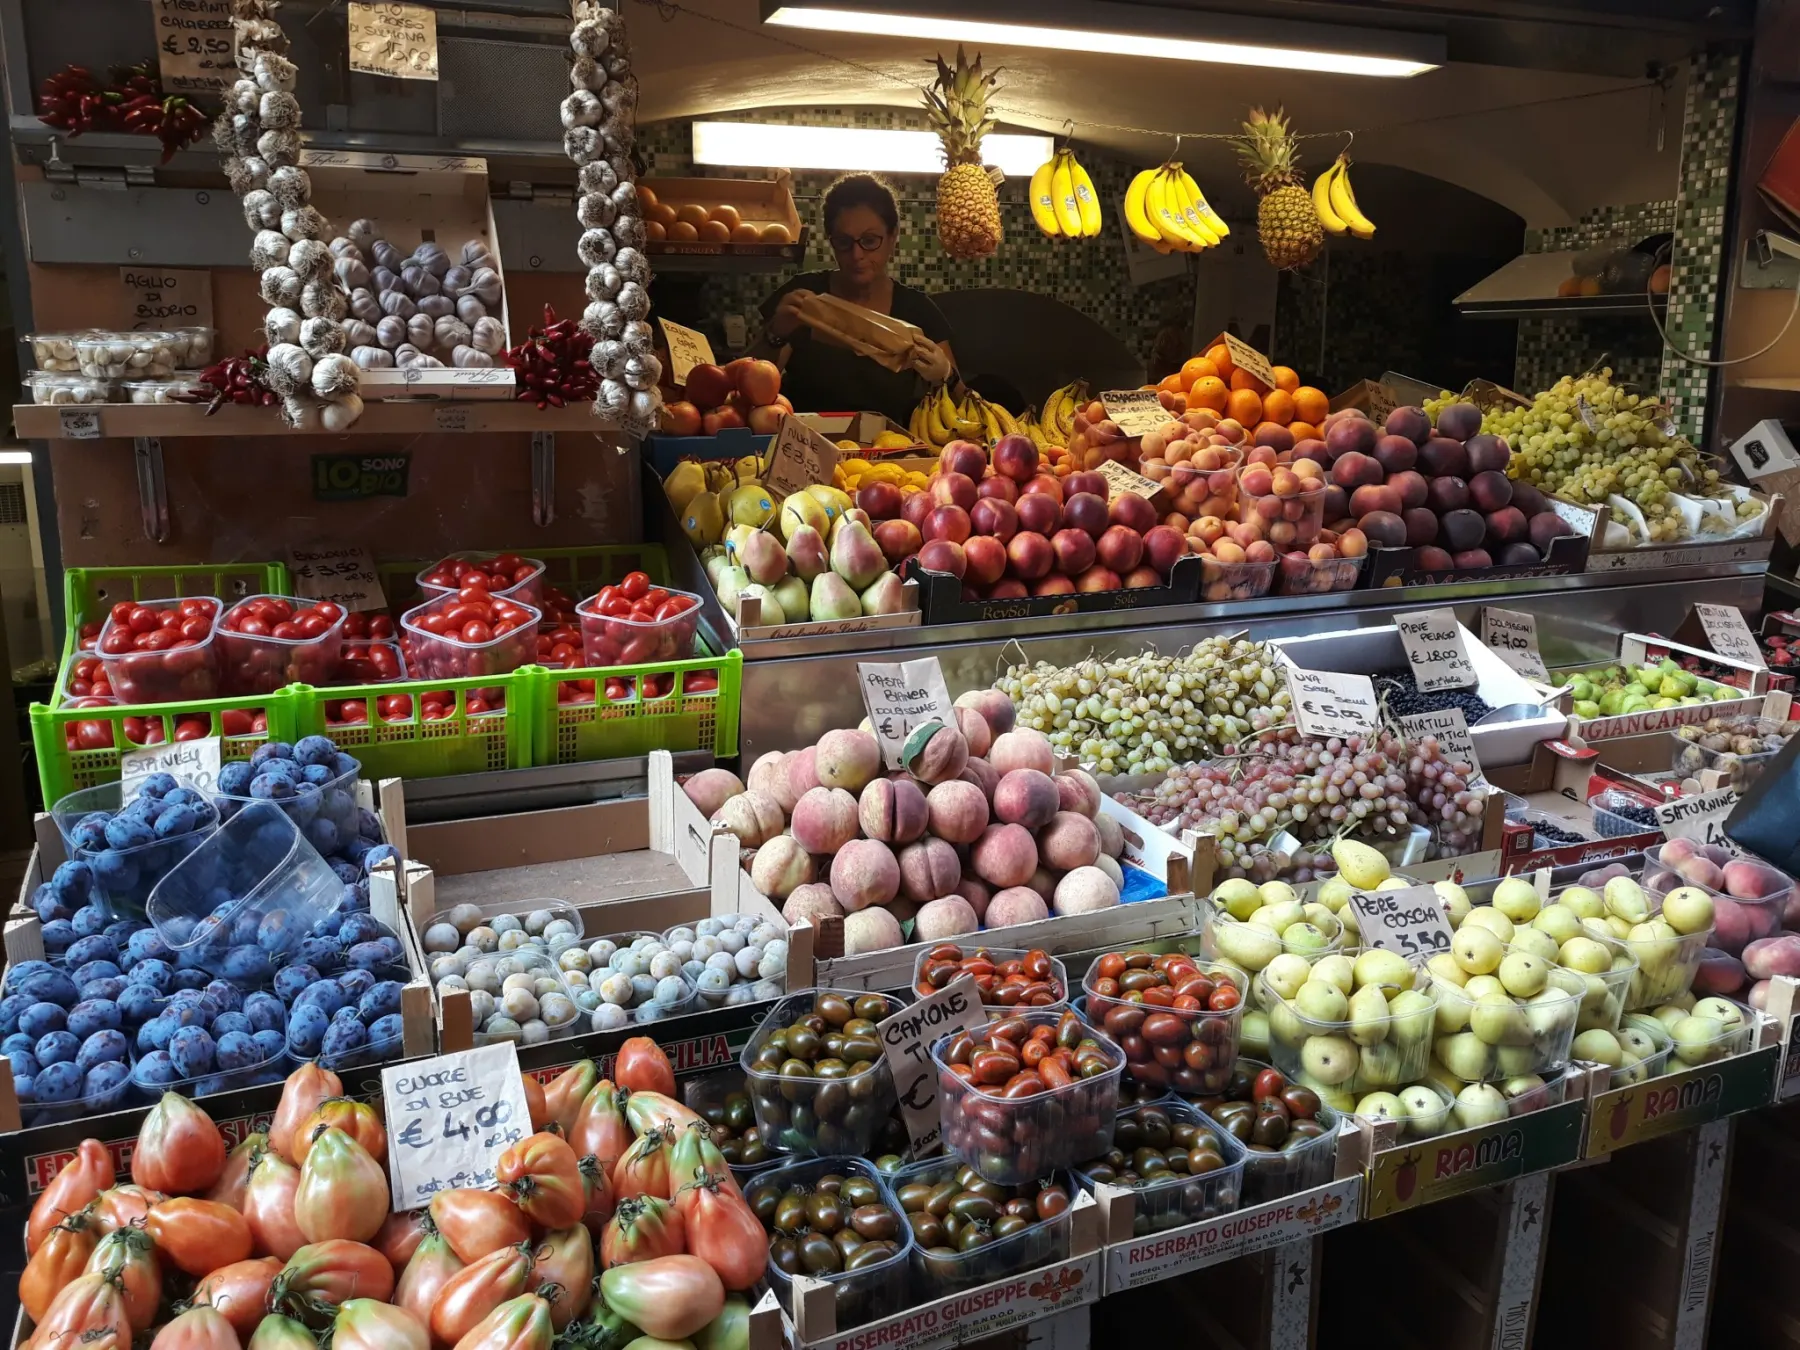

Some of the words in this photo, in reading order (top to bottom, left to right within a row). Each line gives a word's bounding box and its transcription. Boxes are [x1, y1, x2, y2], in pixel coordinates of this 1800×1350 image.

[350, 23, 359, 33] DI
[162, 34, 185, 55] €
[187, 36, 231, 55] 2,50
[351, 41, 371, 52] €
[125, 273, 177, 289] AGLIO
[145, 292, 162, 302] DI
[133, 304, 197, 318] BUDRIO
[781, 442, 792, 458] €
[361, 458, 406, 471] SONO
[361, 471, 403, 494] BIO
[296, 565, 314, 578] €
[1114, 594, 1137, 605] Solo
[1401, 622, 1428, 635] PIEVE
[1420, 630, 1456, 643] PELAGO
[1490, 631, 1499, 647] €
[1501, 631, 1528, 651] 7,00
[1411, 650, 1424, 664] €
[867, 673, 906, 689] PASTA
[1294, 673, 1321, 684] UVA
[883, 688, 930, 702] BIANCA
[1302, 700, 1320, 716] €
[1320, 704, 1363, 719] 5,00
[879, 717, 900, 740] €
[1402, 717, 1455, 736] MIRTILLI
[1587, 705, 1714, 742] GIANCARLO
[123, 748, 203, 774] STANLEY
[1661, 790, 1738, 824] SATURNINE
[1351, 895, 1399, 917] PERE
[1383, 906, 1440, 929] COSCIA
[885, 992, 968, 1045] CAMONE
[395, 1067, 467, 1096] CUORE
[900, 1073, 935, 1110] €
[405, 1097, 431, 1112] DI
[439, 1086, 486, 1109] BUE
[1643, 1073, 1724, 1121] RAMA
[397, 1118, 434, 1149] €
[442, 1099, 513, 1142] 4,00
[1434, 1129, 1524, 1181] RAMA
[1129, 1227, 1218, 1265] RISERBATO
[1221, 1205, 1295, 1240] GIUSEPPE
[836, 1309, 943, 1350] RISERBATO
[941, 1281, 1028, 1322] GIUSEPPE
